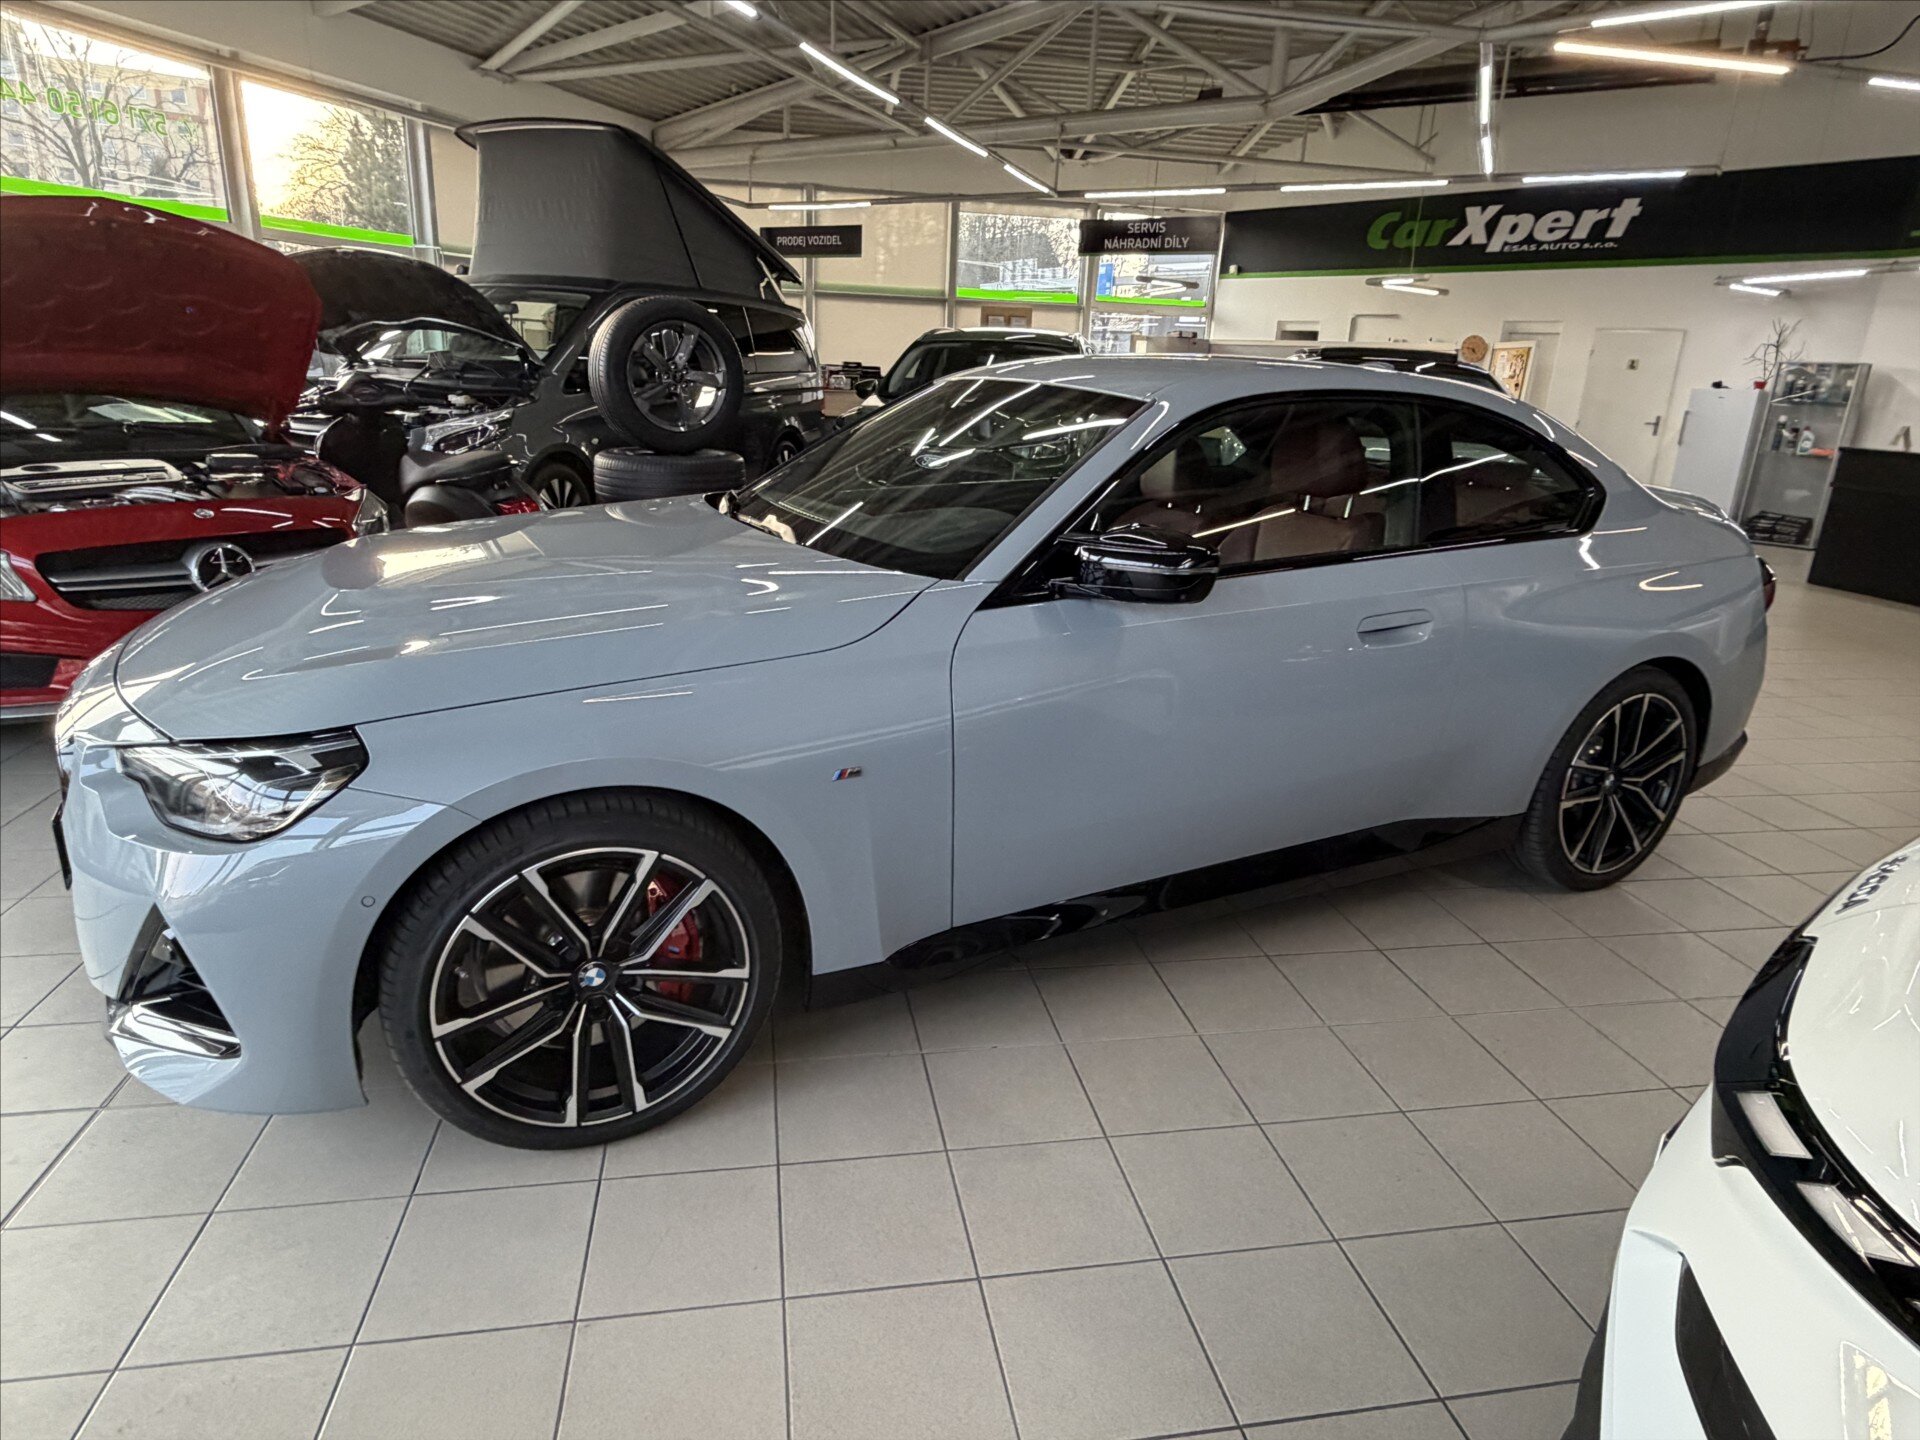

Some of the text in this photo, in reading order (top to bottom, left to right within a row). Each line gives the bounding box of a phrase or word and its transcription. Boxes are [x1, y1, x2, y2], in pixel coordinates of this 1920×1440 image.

[1127, 221, 1167, 234] SERVIS
[1366, 197, 1644, 254] CarXpert
[776, 235, 842, 247] PRODEJ VOZIDEL
[1104, 234, 1190, 250] NÁHRADNÍ DÍLY
[1503, 241, 1618, 253] ESAS AUTO s.r.o.
